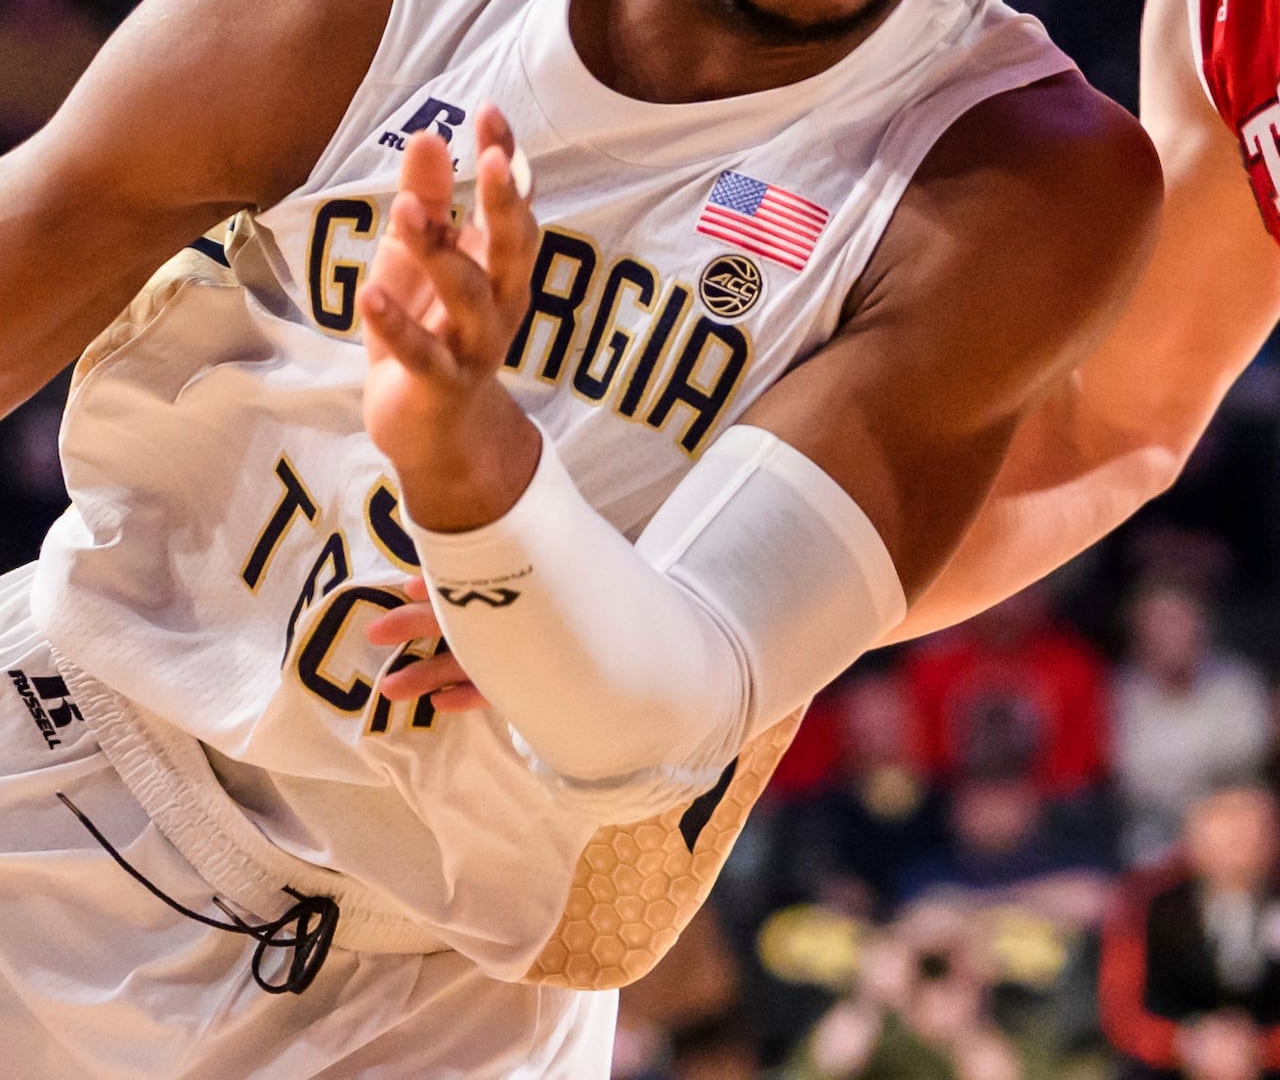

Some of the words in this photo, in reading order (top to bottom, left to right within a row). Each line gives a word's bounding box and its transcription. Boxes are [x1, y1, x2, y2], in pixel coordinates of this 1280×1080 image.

[707, 272, 759, 298] ACC
[307, 196, 756, 460] GRGIA
[8, 670, 62, 750] RUSSELL
